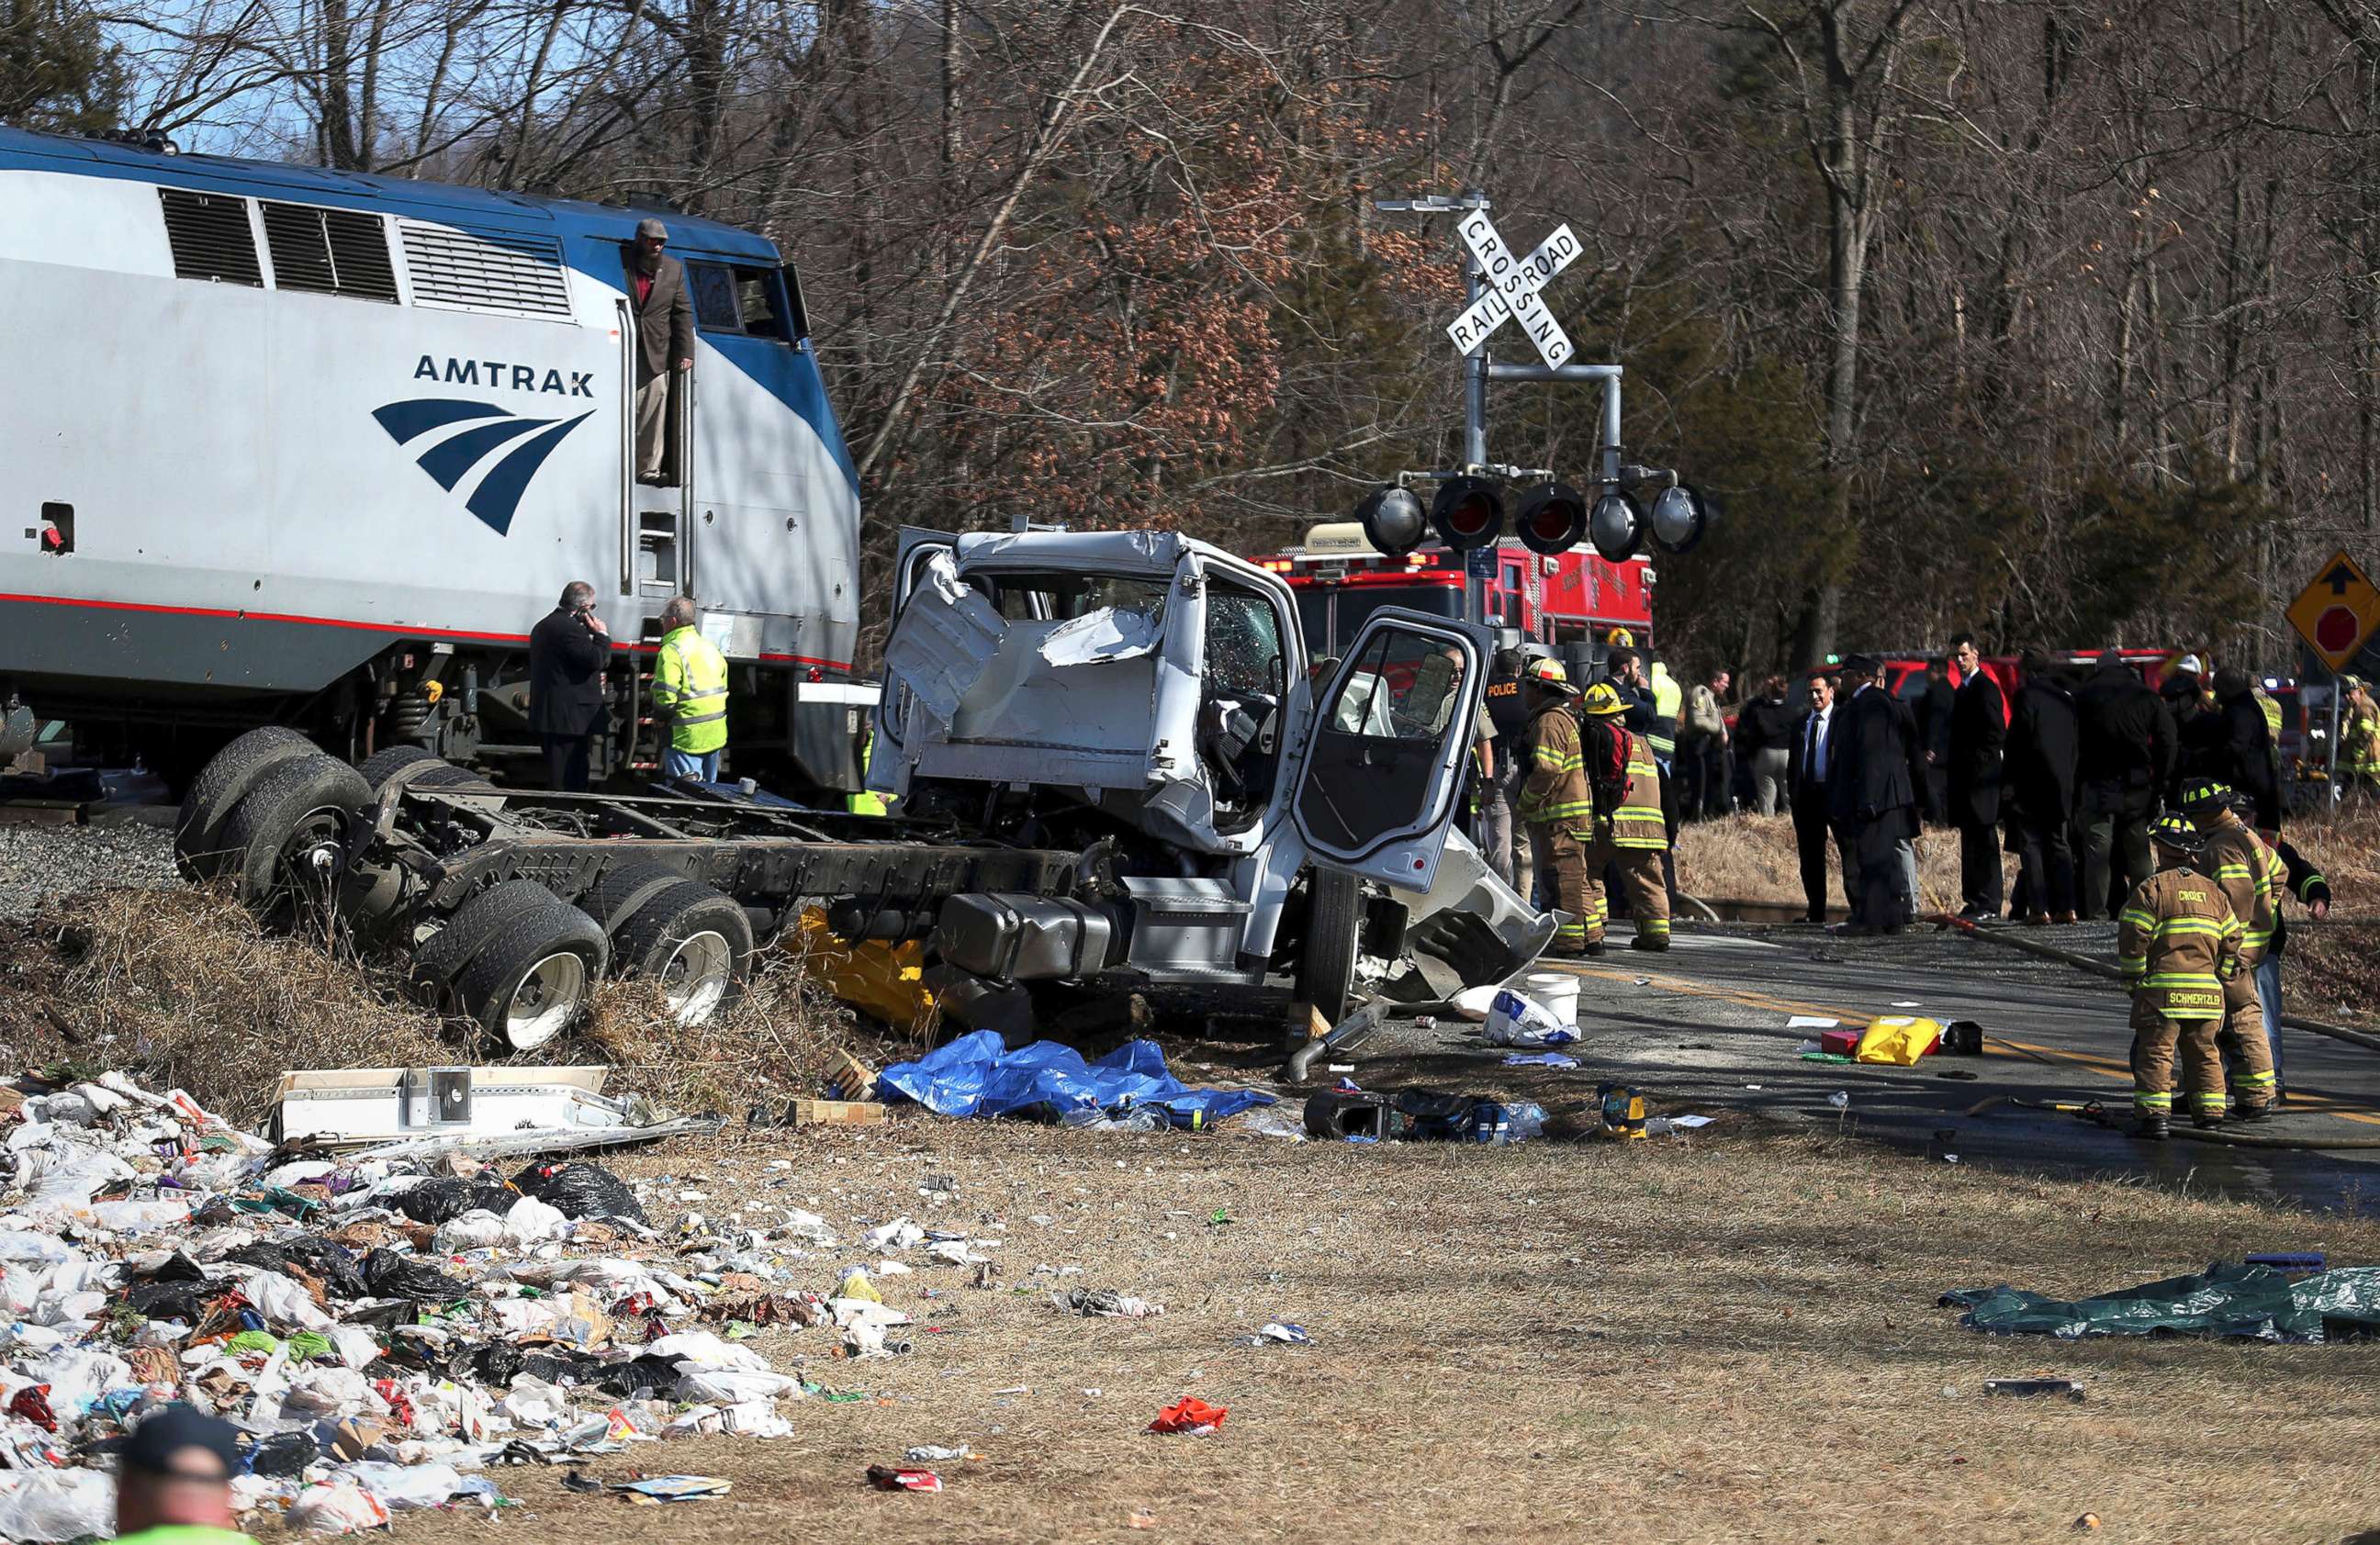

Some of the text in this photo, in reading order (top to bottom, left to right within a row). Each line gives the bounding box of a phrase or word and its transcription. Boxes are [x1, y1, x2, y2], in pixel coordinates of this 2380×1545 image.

[1467, 219, 1566, 361] CROSSING
[413, 354, 595, 398] AMTRAK
[1488, 682, 1518, 698] POLICE
